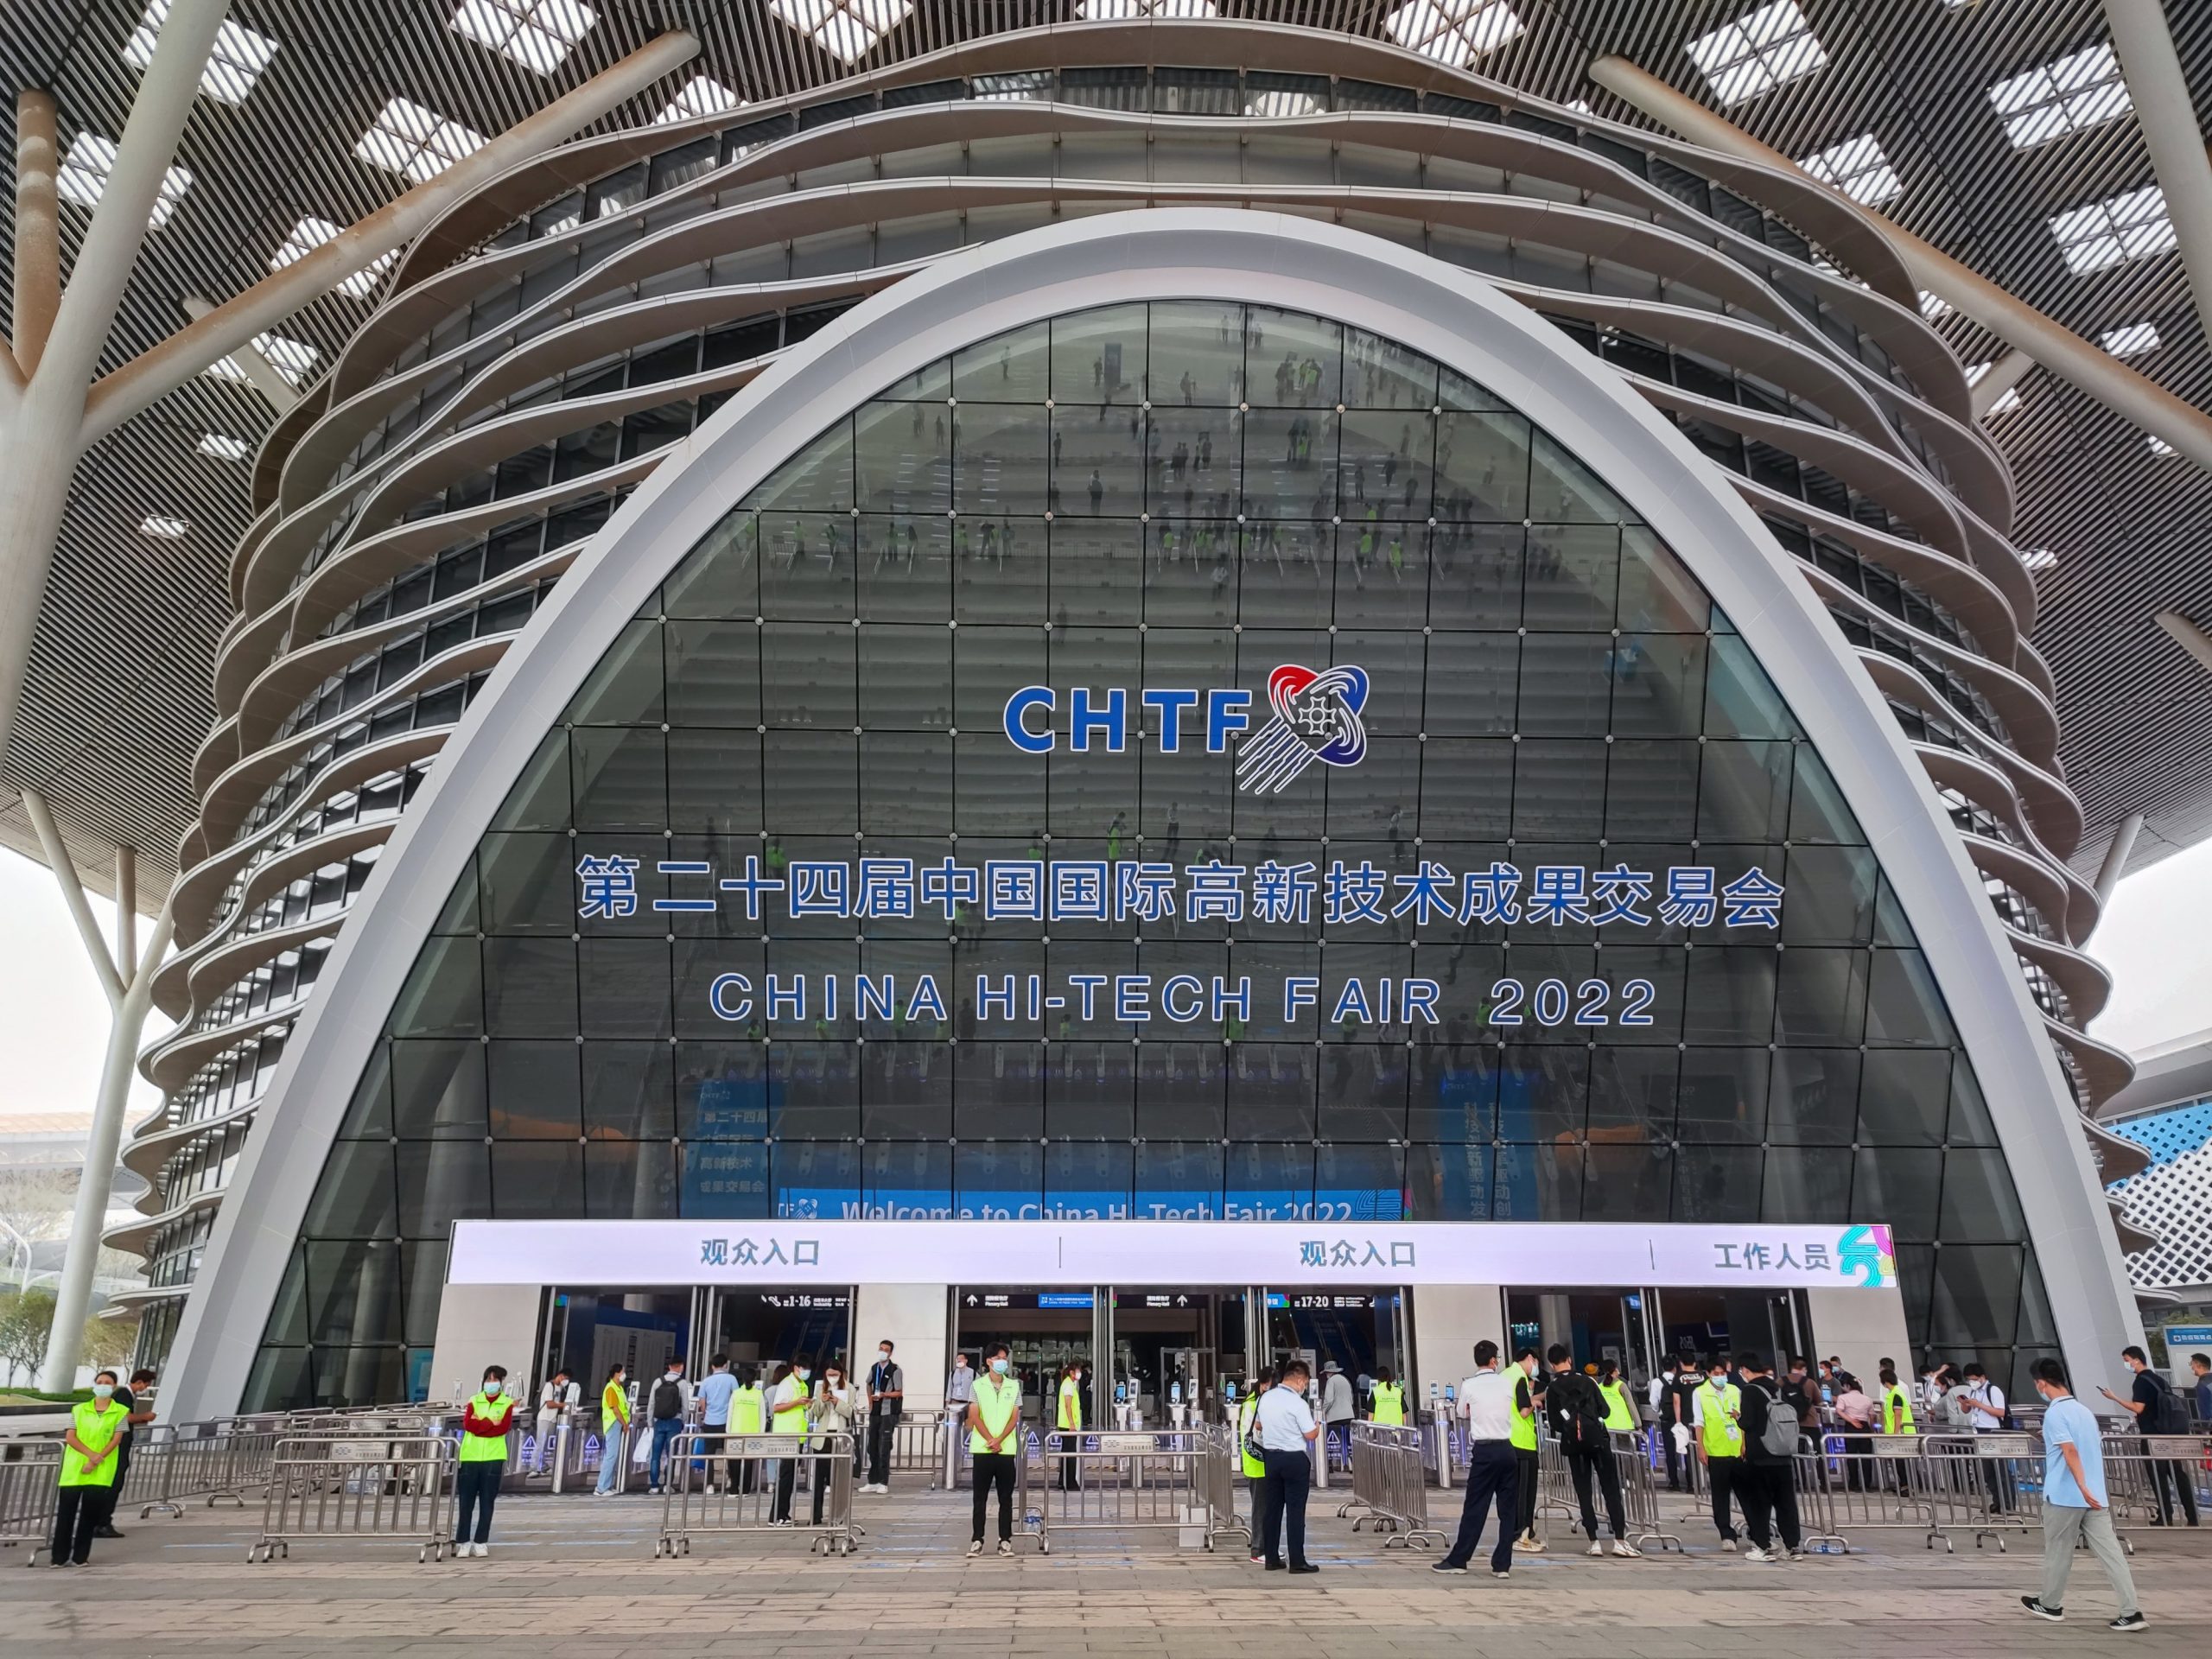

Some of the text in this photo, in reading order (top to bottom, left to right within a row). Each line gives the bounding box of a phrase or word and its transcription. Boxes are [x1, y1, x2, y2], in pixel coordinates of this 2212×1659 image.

[1003, 685, 1252, 753] CHTF
[575, 854, 1785, 930] 第二十四届中国国际高新技术成果交易会
[709, 972, 1656, 1027] CHINA HI-TECH FAIR 2022
[842, 1200, 974, 1220] Welcome
[981, 1204, 1010, 1220] to
[1018, 1202, 1100, 1220] China
[1224, 1201, 1277, 1221] Fair
[700, 1237, 820, 1266] 观众入口
[1299, 1239, 1416, 1268] 观众入口
[1713, 1243, 1832, 1271] 工作人员
[789, 1295, 811, 1307] 1-16
[1300, 1295, 1329, 1307] 17-20
